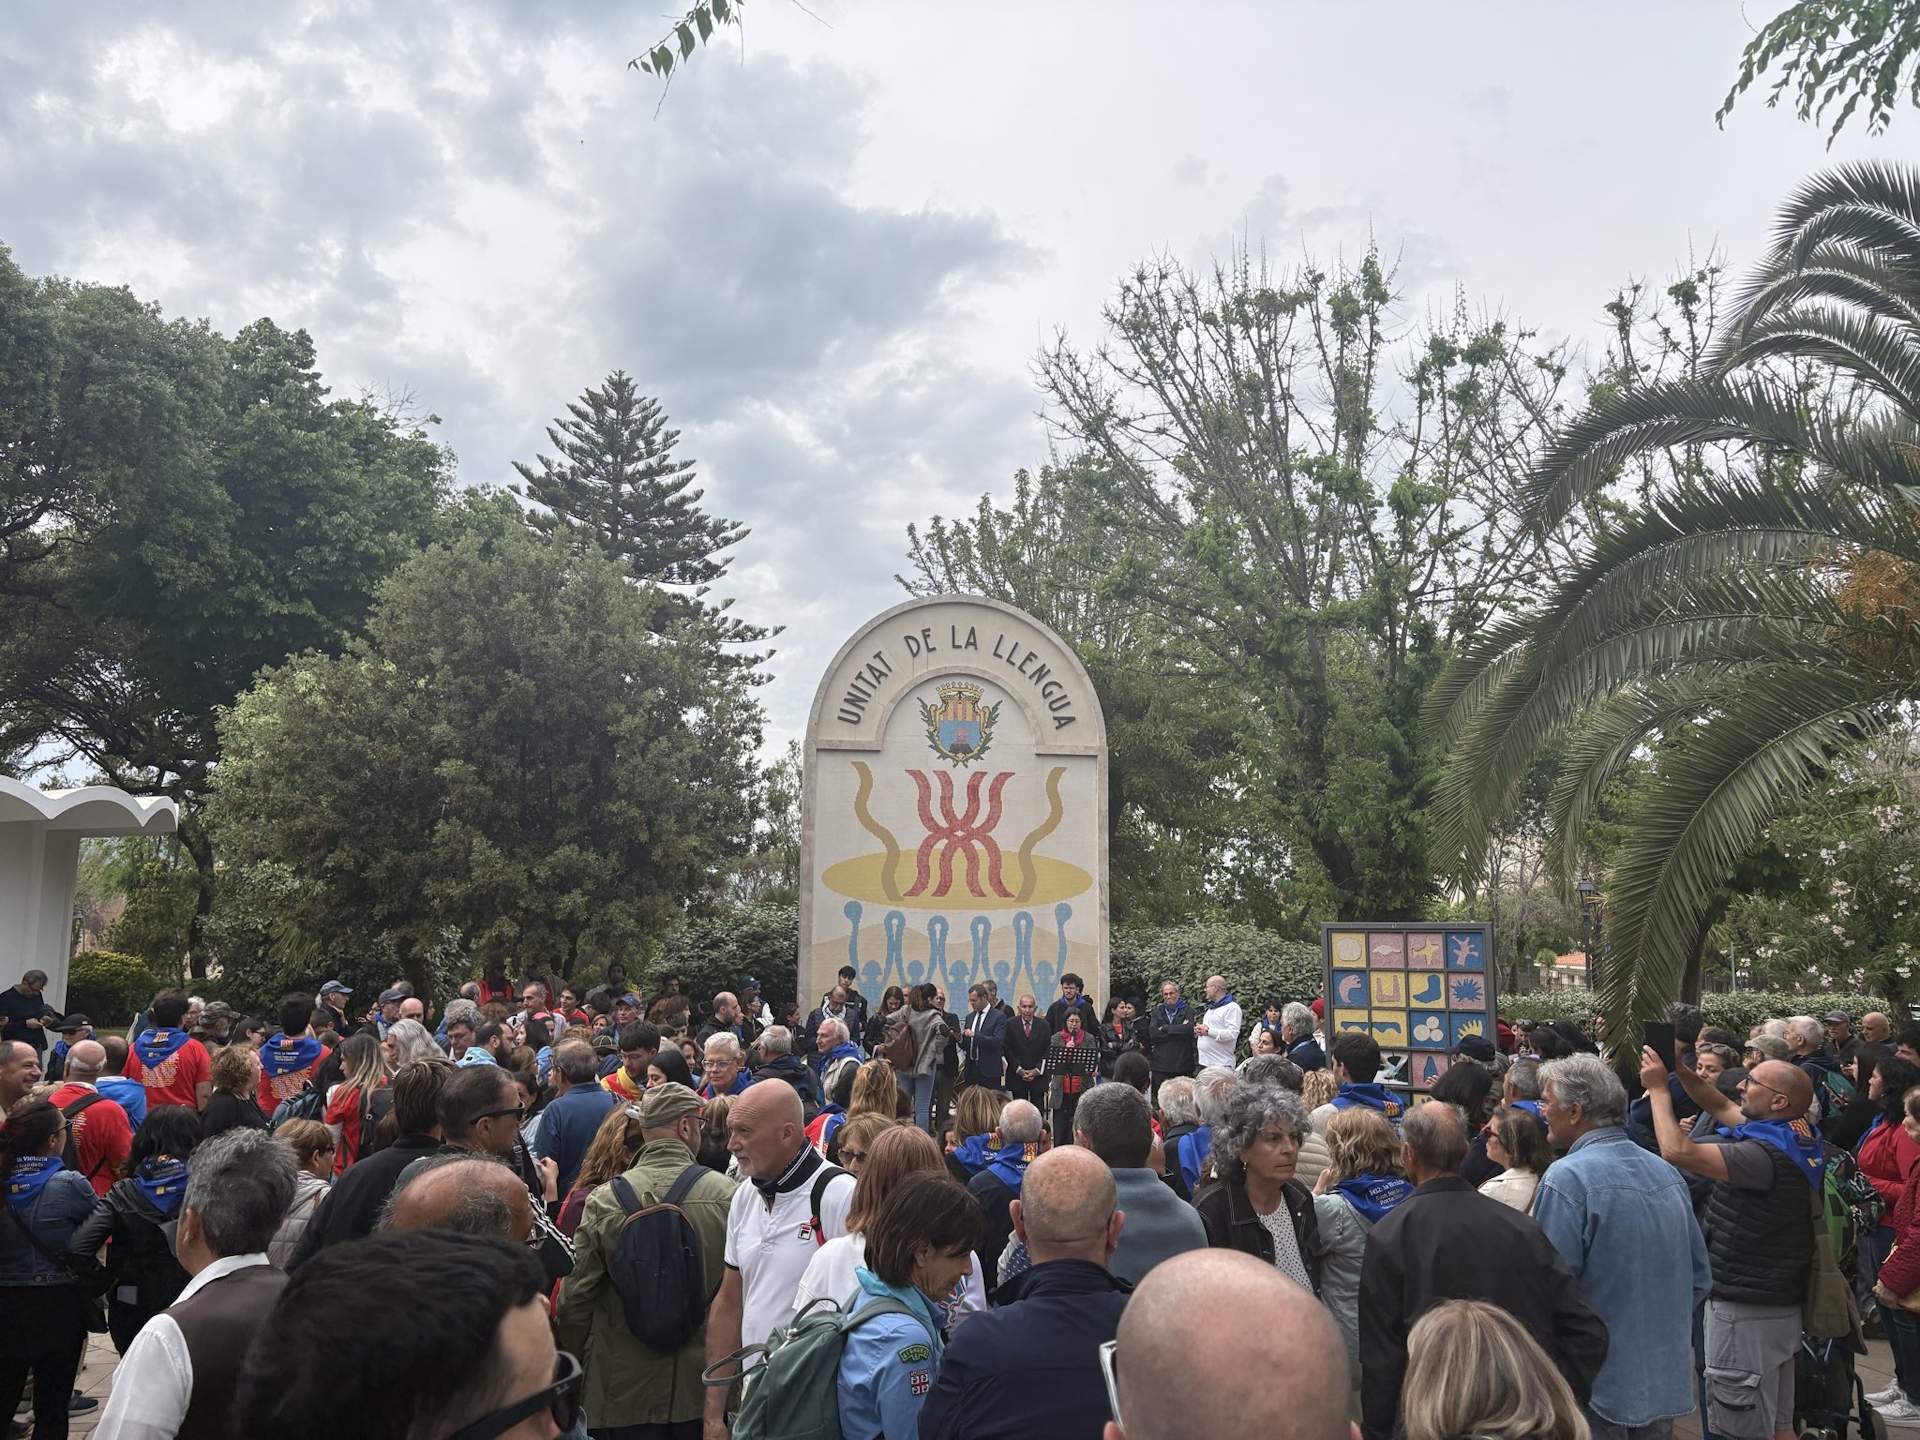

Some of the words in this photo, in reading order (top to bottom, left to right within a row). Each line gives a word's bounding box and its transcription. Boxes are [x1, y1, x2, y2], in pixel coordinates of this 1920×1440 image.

[838, 650, 893, 725] UNITAT
[904, 627, 937, 658] DE
[951, 625, 978, 650] LA
[992, 634, 1076, 730] LLENGUA
